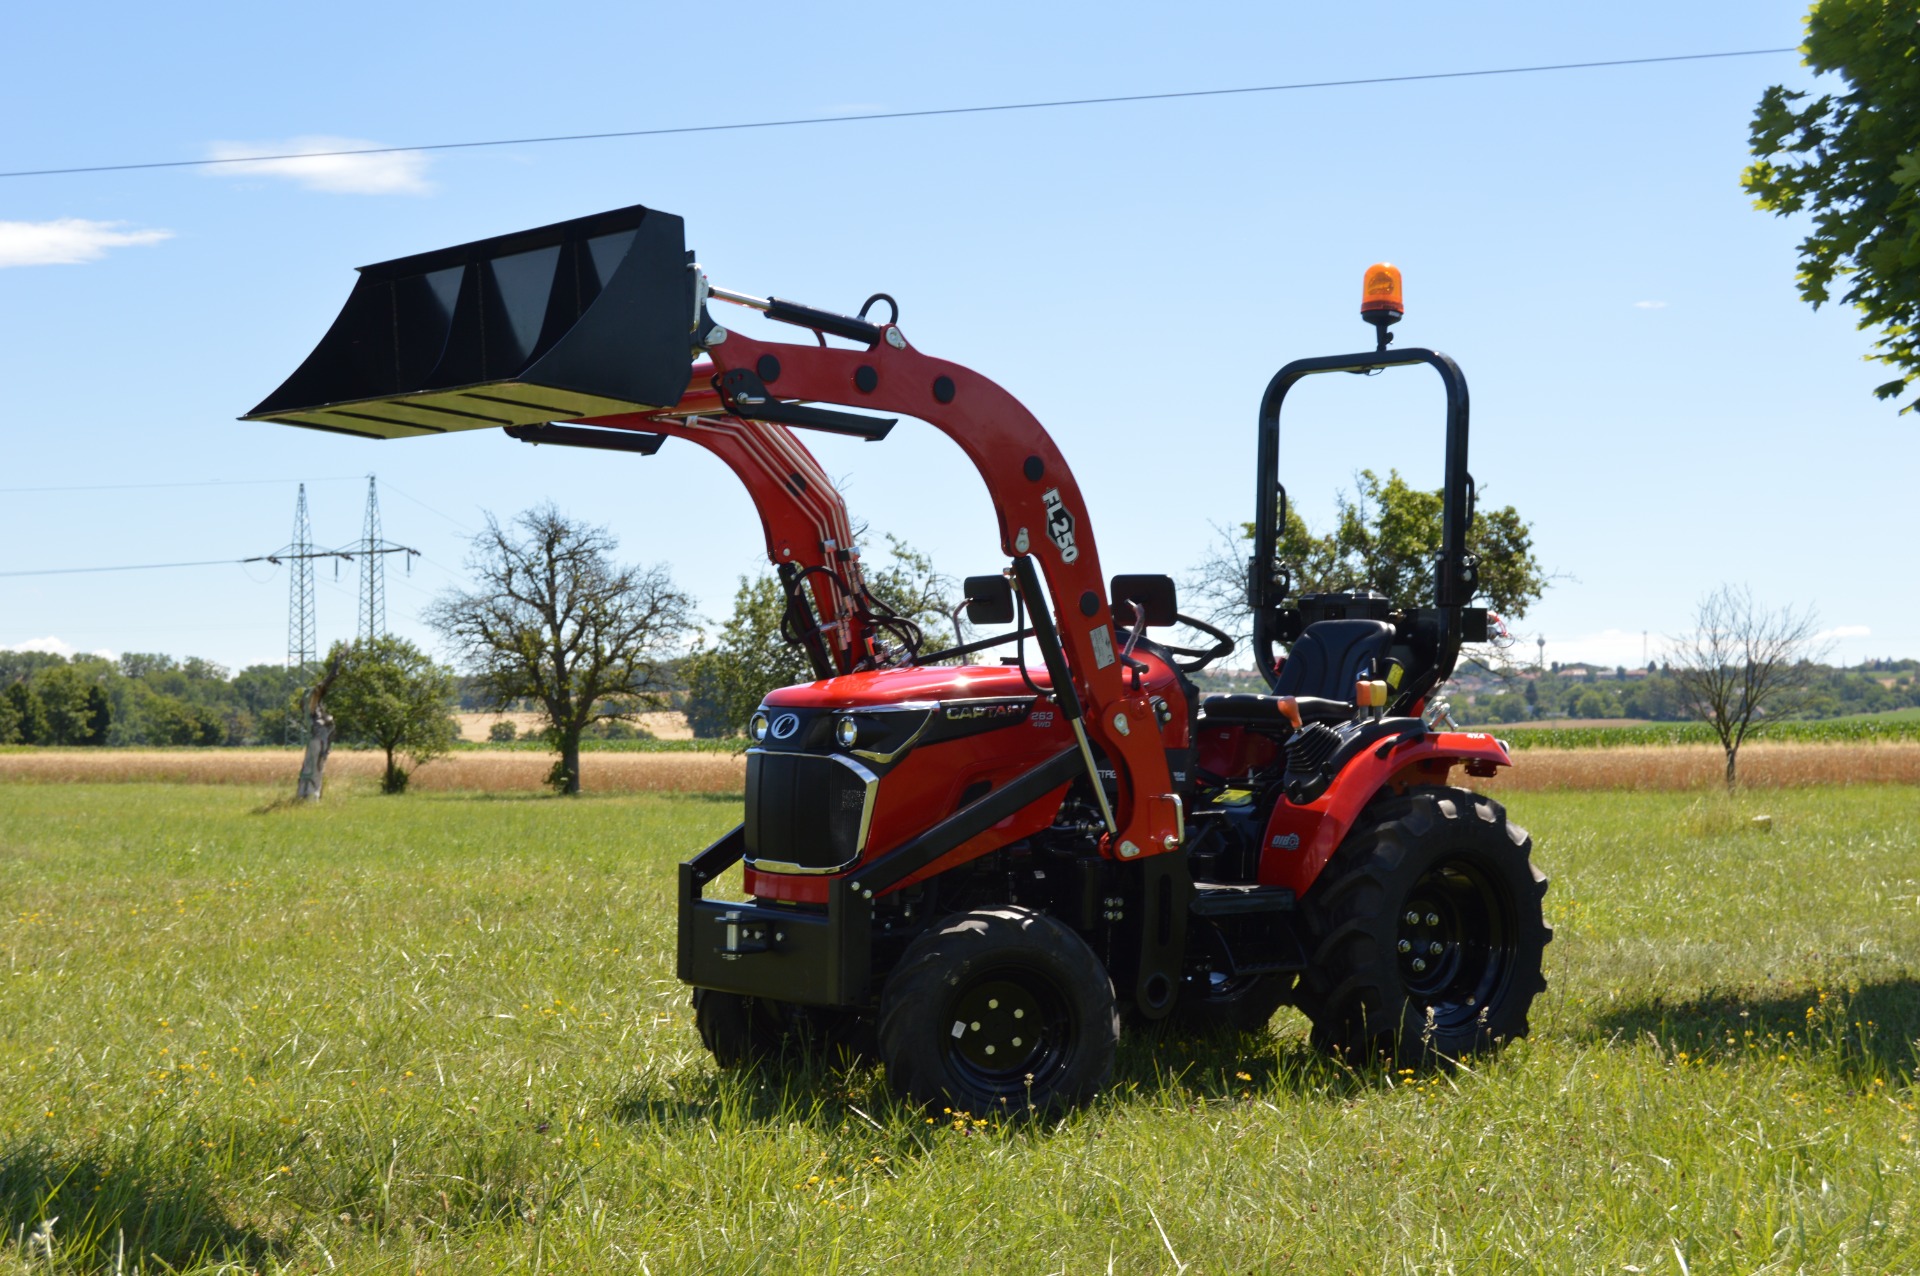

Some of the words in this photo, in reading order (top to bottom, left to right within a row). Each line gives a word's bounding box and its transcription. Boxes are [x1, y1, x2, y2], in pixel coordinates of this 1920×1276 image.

[1042, 488, 1079, 563] FL250
[946, 704, 1026, 720] CAPTAIN
[1031, 711, 1054, 721] 263
